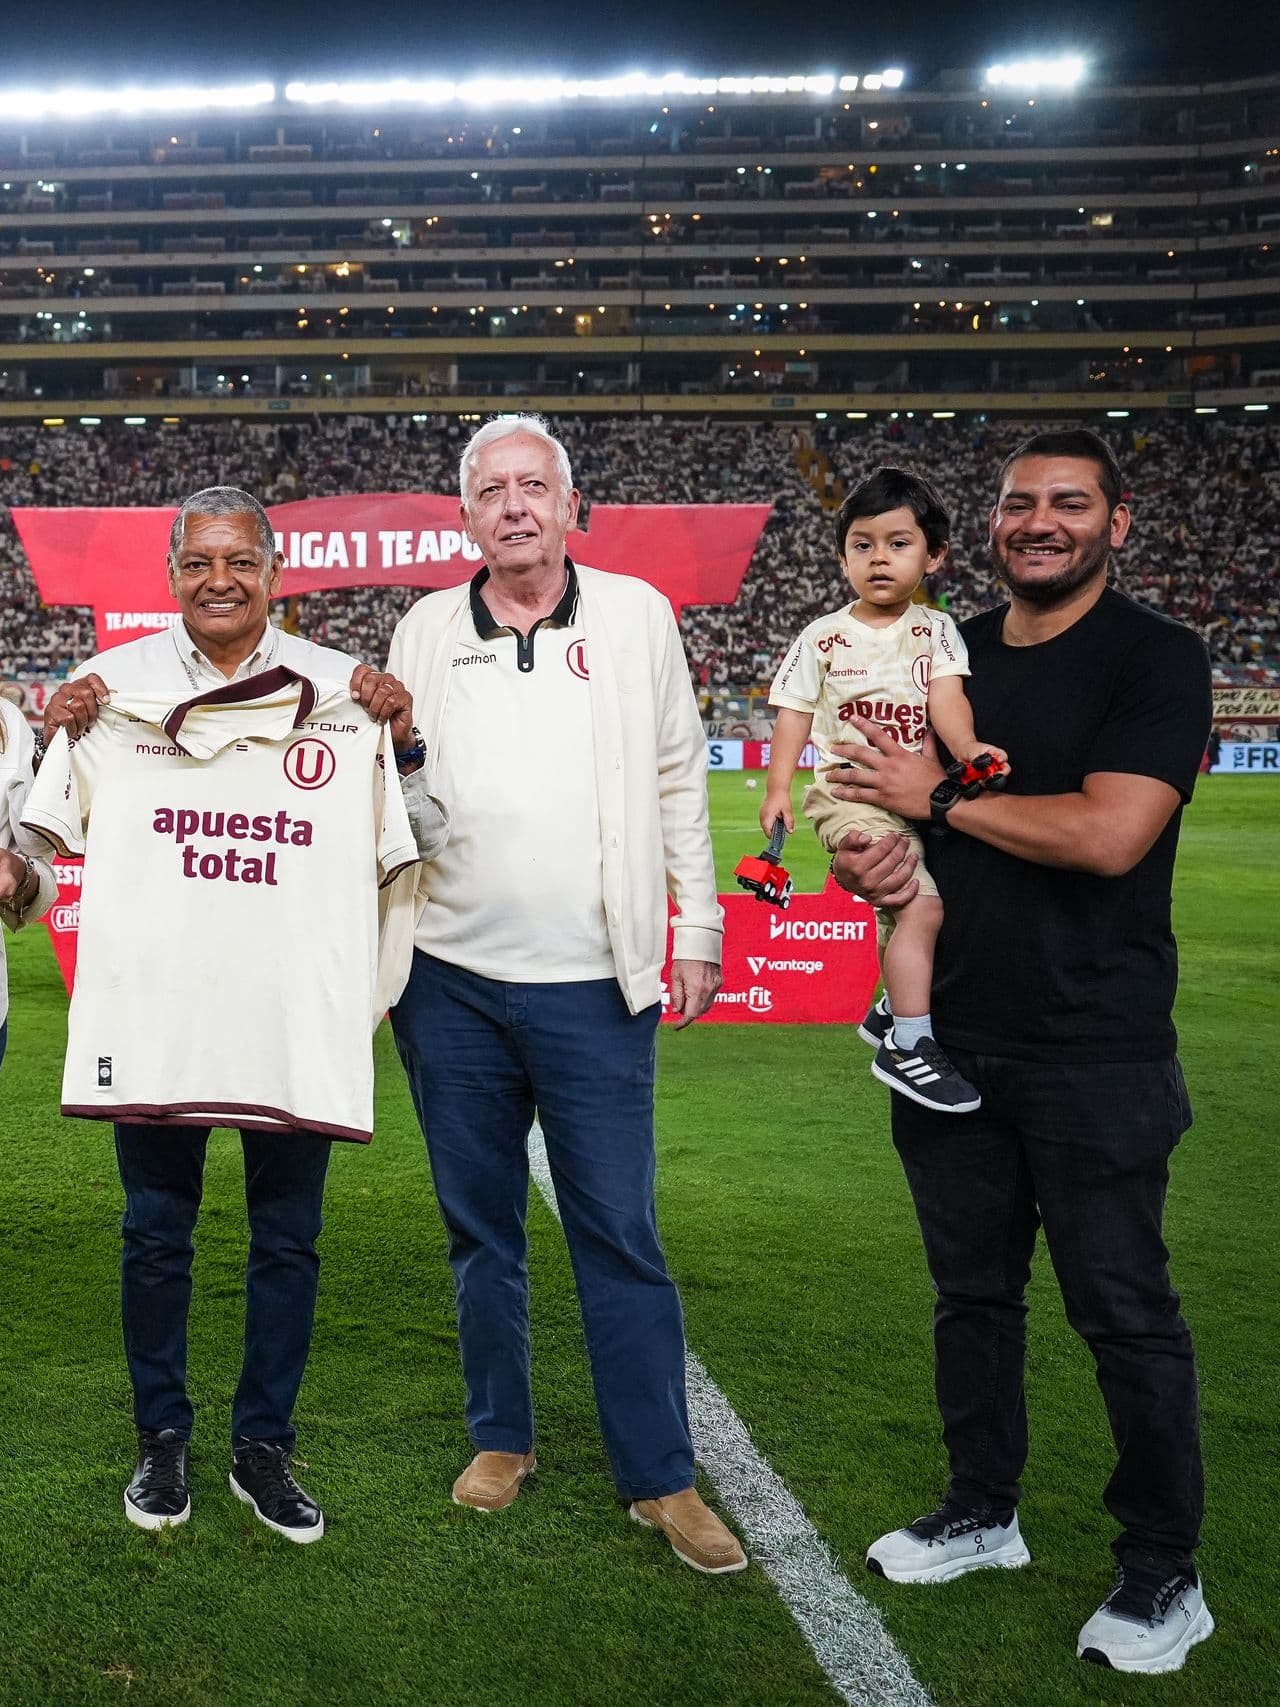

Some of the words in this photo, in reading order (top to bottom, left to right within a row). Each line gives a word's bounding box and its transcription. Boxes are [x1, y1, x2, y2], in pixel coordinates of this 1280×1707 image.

[295, 748, 324, 784] U
[153, 807, 313, 847] apuesta
[182, 845, 278, 886] total
[767, 958, 824, 974] vantage
[748, 986, 773, 1006] fit
